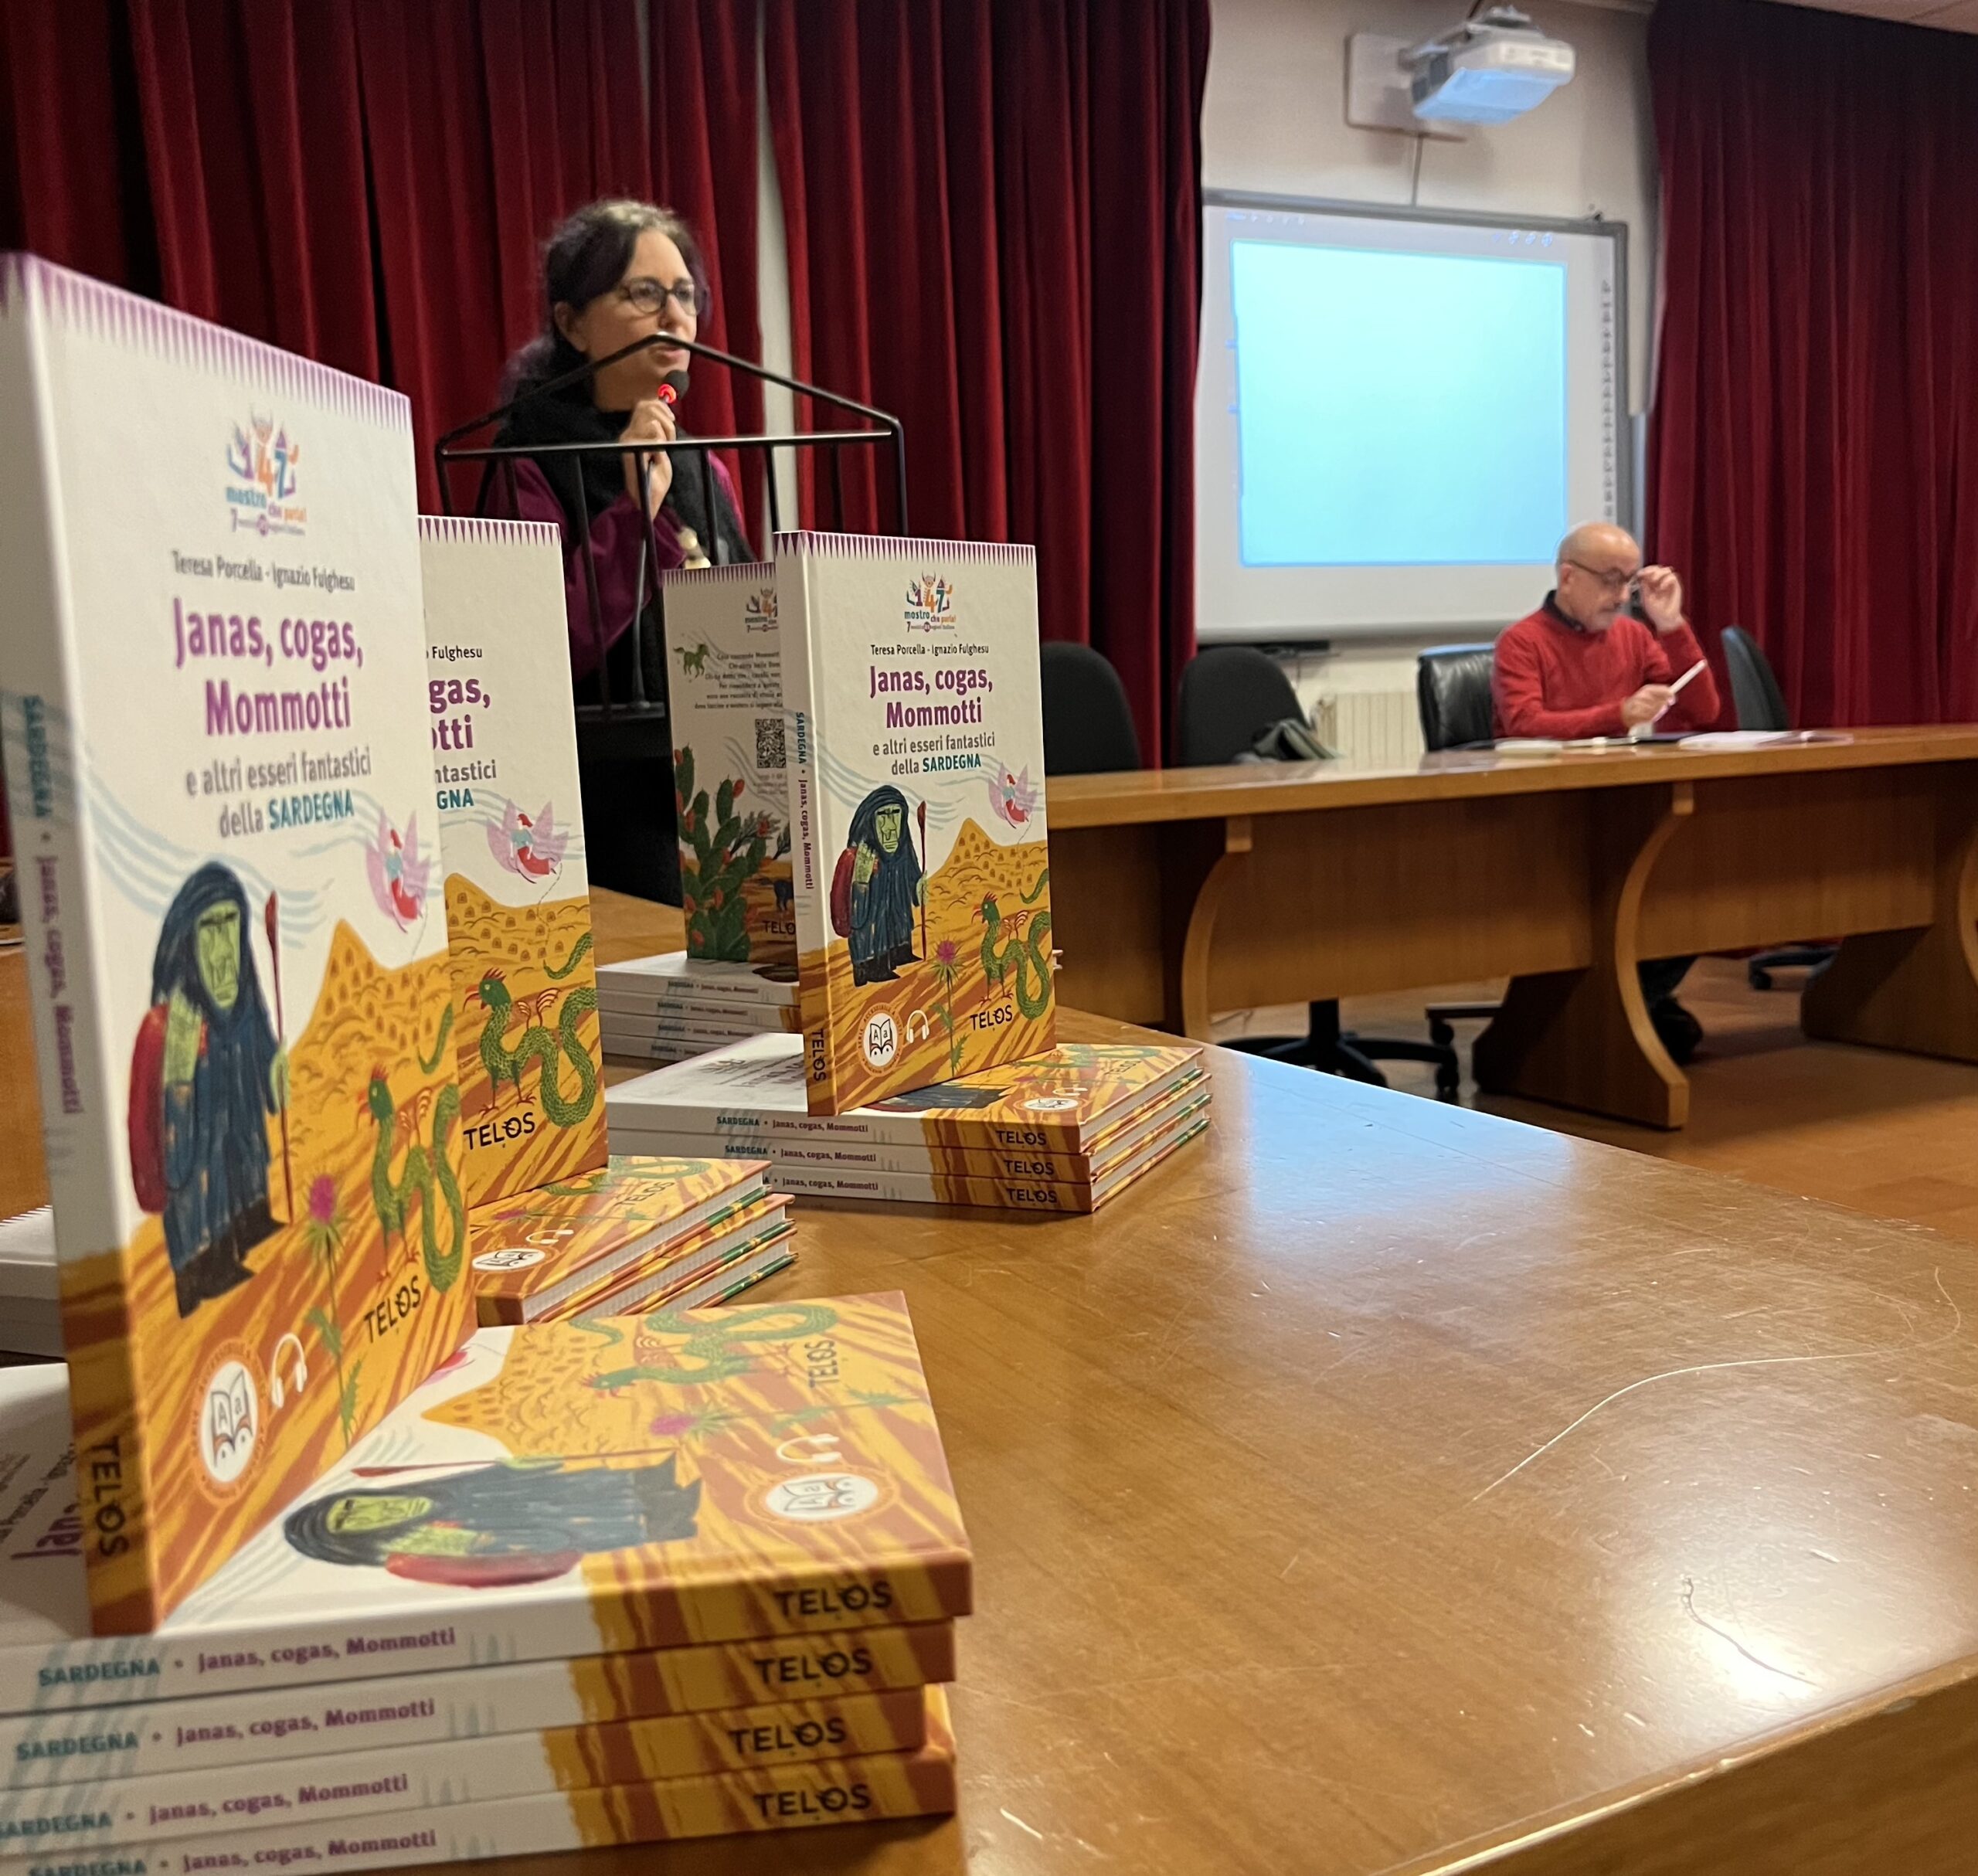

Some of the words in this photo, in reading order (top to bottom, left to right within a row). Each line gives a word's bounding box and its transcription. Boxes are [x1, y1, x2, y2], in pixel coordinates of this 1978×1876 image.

[172, 549, 213, 578] Teresa
[216, 555, 263, 582] Porcella
[273, 562, 311, 590] Ignazio
[313, 567, 355, 593] Fulghesu
[904, 610, 930, 620] mostro
[174, 596, 274, 669] Janas,
[280, 617, 363, 671] cogas,
[871, 644, 895, 655] Teresa
[897, 644, 926, 655] Porcella
[932, 644, 957, 657] Ignazio
[959, 644, 989, 657] Fulghesu
[432, 645, 483, 662] Fulghesu
[429, 678, 491, 714] gas,
[870, 665, 930, 698] Janas,
[935, 669, 994, 696] cogas,
[206, 675, 352, 736] Mommotti
[886, 696, 982, 729] Mommotti
[796, 712, 807, 764] SARDEGNA
[872, 745, 880, 756] e
[882, 738, 907, 756] altri
[910, 736, 943, 753] esseri
[946, 731, 995, 750] fantastici
[185, 771, 198, 797] e
[203, 757, 243, 795] altri
[247, 752, 298, 790] esseri
[301, 745, 372, 782] fantastici
[435, 759, 497, 783] ntastici
[891, 760, 919, 776] della
[923, 753, 981, 773] SARDEGNA
[437, 788, 474, 810] GNA
[798, 779, 808, 808] Janas,
[219, 801, 264, 838] della
[267, 789, 355, 830] SARDEGNA
[800, 810, 810, 840] cogas,
[803, 842, 814, 890] Mommotti
[762, 920, 796, 935] TELO
[970, 1004, 1013, 1031] TELOS
[811, 1028, 827, 1082] TELOS
[464, 1111, 535, 1150] TELOS
[716, 1116, 760, 1127] SARDEGNA
[773, 1120, 797, 1130] Janas,
[799, 1122, 825, 1132] cogas,
[827, 1123, 868, 1133] Mommotti
[996, 1130, 1047, 1146] TELOS
[725, 1144, 768, 1155] SARDEGNA
[780, 1148, 805, 1159] Janas,
[807, 1151, 833, 1161] cogas,
[834, 1152, 876, 1162] Mommotti
[1004, 1160, 1055, 1176] TELOS
[783, 1178, 807, 1188] Janas,
[808, 1180, 834, 1190] cogas,
[837, 1180, 879, 1191] Mommotti
[1007, 1188, 1058, 1203] TELOS
[364, 1275, 422, 1344] TELOS
[92, 1435, 130, 1558] TELOS
[775, 1581, 892, 1616] TELOS
[39, 1658, 161, 1687] SARDEGNA
[198, 1653, 265, 1674] Janas,
[270, 1643, 340, 1664] cogas,
[345, 1627, 456, 1656] Mommotti
[753, 1648, 873, 1684] TELOS
[16, 1731, 139, 1762] SARDEGNA
[176, 1726, 243, 1748] Janas,
[249, 1715, 318, 1738] cogas,
[325, 1698, 435, 1728] Mommotti
[729, 1718, 847, 1752] TELOS
[149, 1804, 217, 1826] Janas,
[223, 1793, 292, 1815] cogas,
[298, 1773, 408, 1804] Mommotti
[753, 1783, 871, 1818] TELOS
[183, 1854, 249, 1873] Janas,
[253, 1845, 322, 1865] cogas,
[328, 1829, 437, 1856] Mommotti
